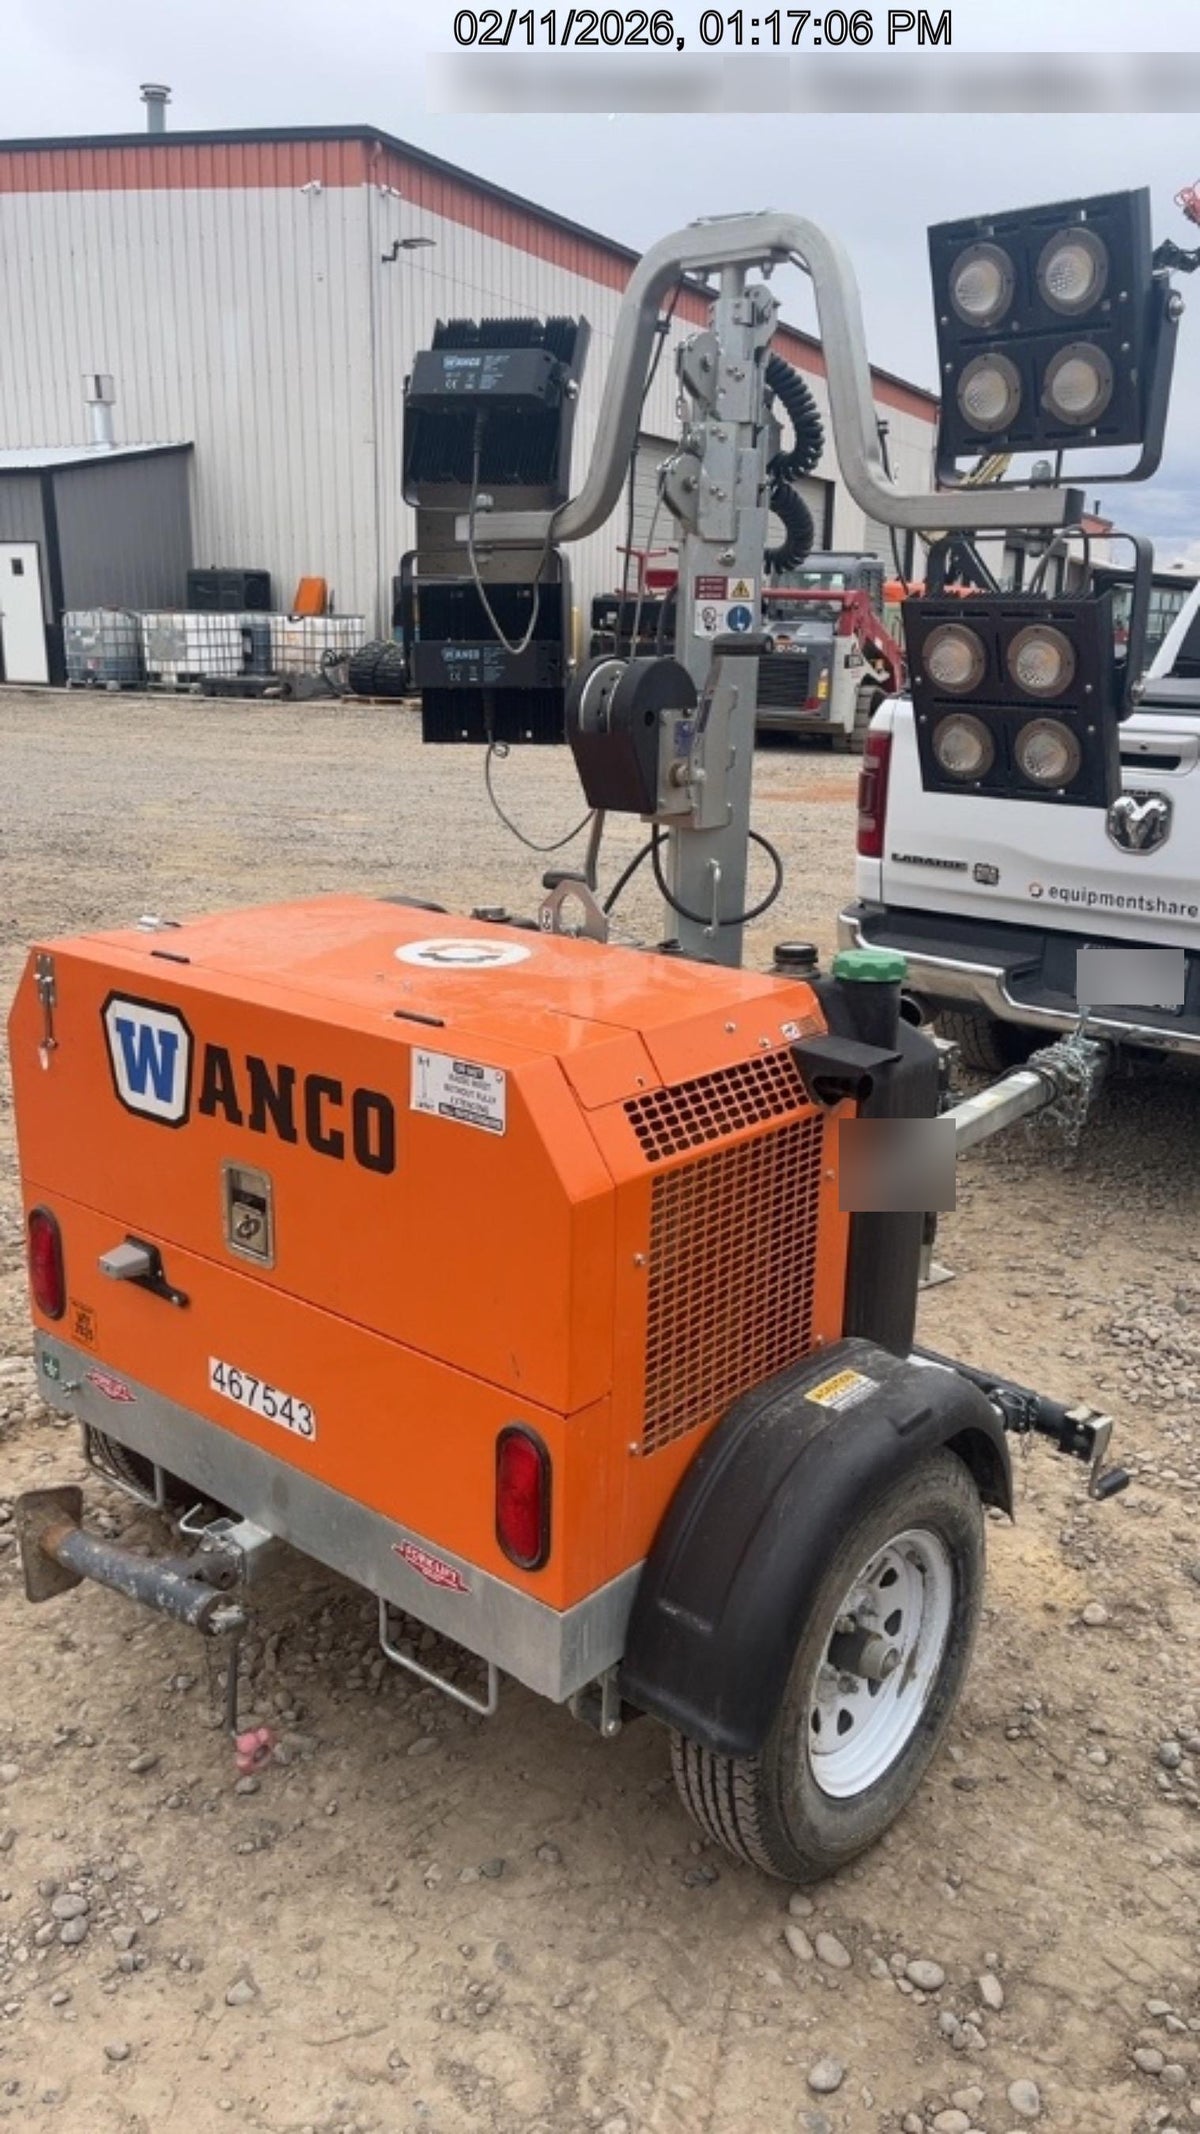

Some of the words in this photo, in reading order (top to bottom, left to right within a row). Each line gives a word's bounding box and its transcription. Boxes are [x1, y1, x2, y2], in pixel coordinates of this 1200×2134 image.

[1048, 884, 1199, 918] equipmentshare
[110, 1008, 396, 1176] WANCO
[212, 1361, 313, 1436] 467543
